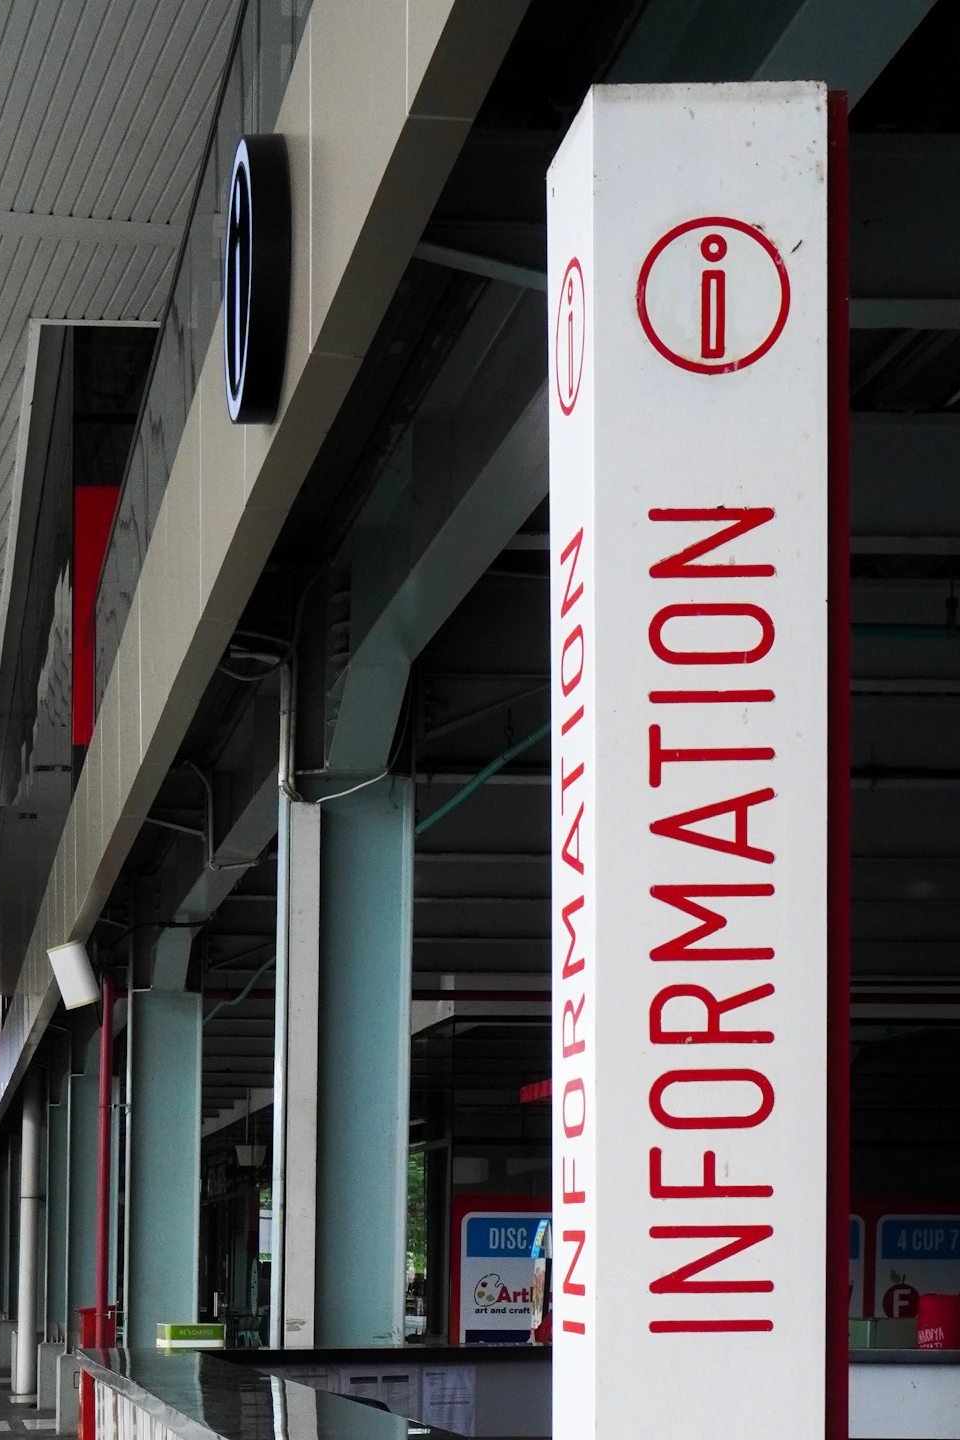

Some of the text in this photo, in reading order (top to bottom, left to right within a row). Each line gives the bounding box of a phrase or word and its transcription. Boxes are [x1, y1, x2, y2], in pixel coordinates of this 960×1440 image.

[559, 527, 584, 1336] INFORMATION
[648, 507, 774, 1334] INFORMATION
[489, 1227, 532, 1250] DISC.
[897, 1228, 907, 1251] 4
[912, 1228, 945, 1251] CUP
[490, 1306, 506, 1314] and
[509, 1306, 530, 1314] craft
